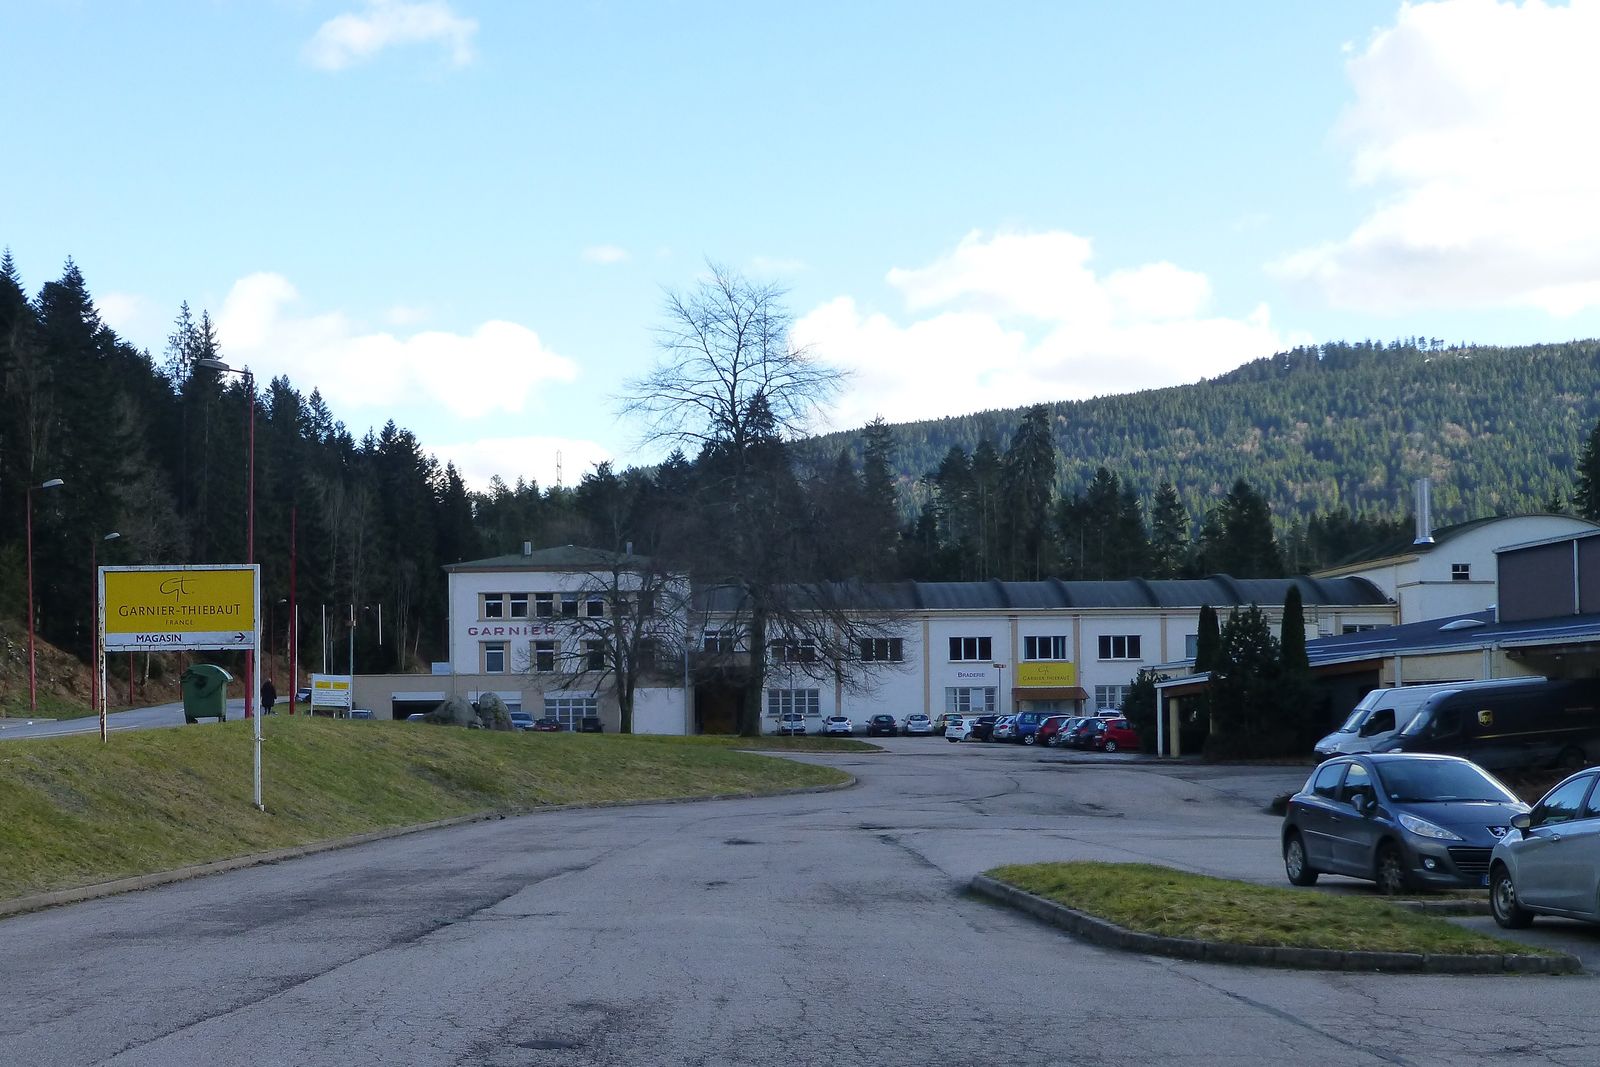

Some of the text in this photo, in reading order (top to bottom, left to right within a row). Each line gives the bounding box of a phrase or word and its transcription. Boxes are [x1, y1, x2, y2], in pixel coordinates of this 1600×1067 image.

[118, 603, 241, 617] GARNIER-THIEBAUT
[468, 626, 555, 636] GARNIER
[136, 634, 182, 643] MAGASIN
